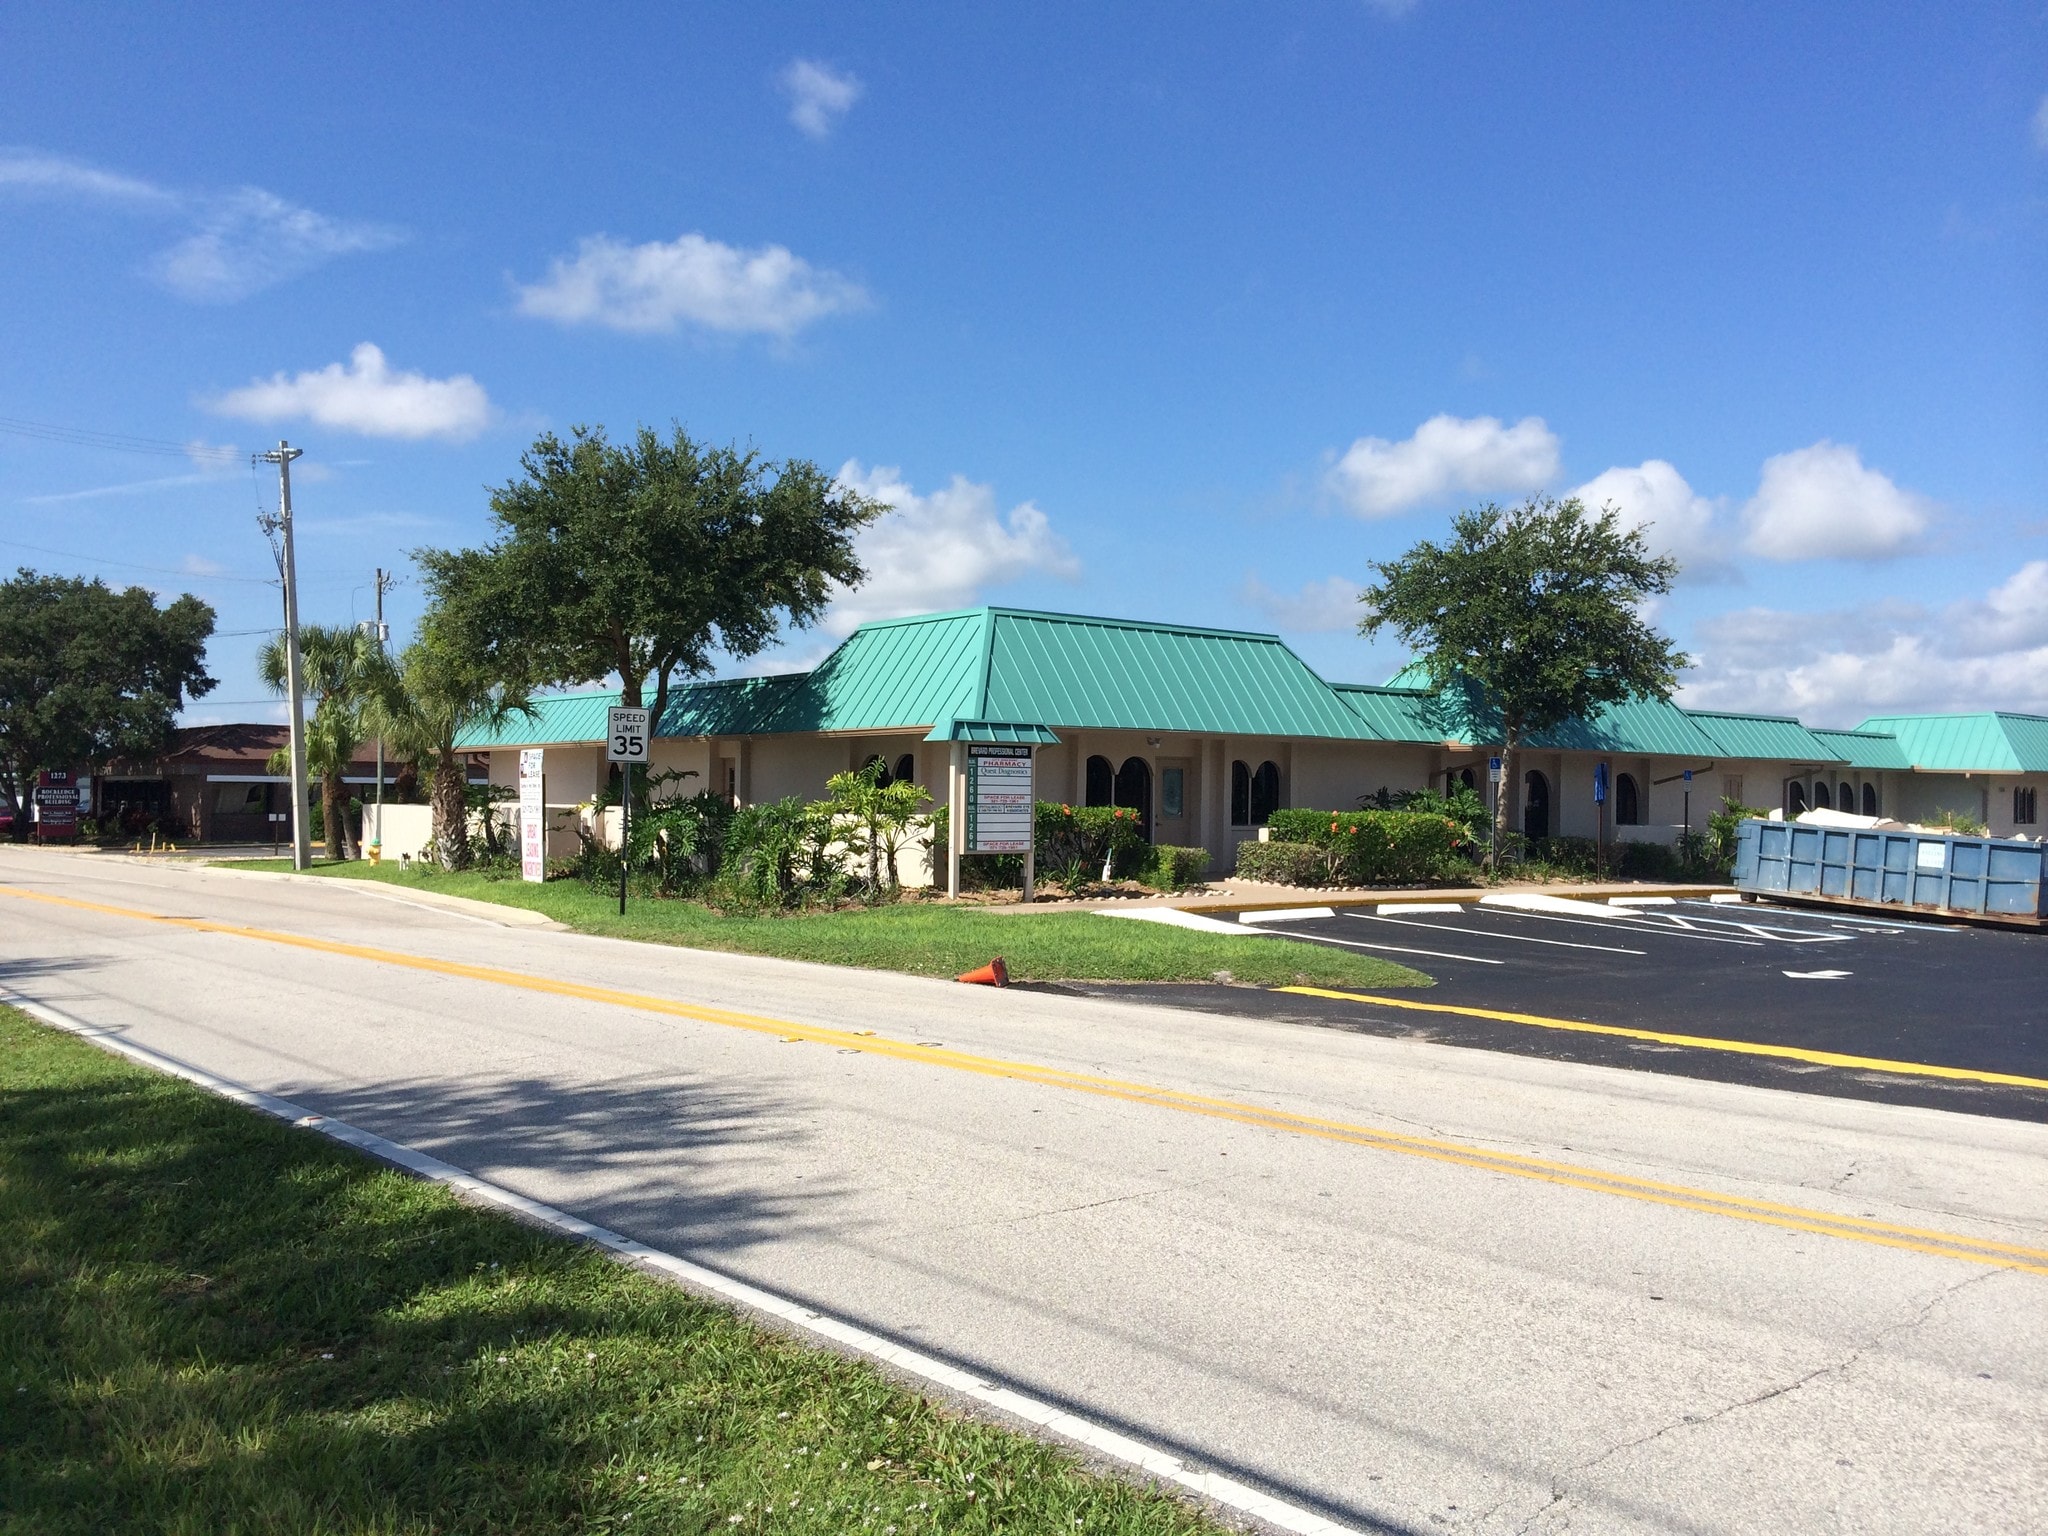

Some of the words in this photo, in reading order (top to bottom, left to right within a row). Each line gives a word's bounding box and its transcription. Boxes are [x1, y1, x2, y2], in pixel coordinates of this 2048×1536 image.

[613, 713, 645, 722] SPEED
[616, 724, 641, 733] LIMIT
[613, 736, 643, 755] 35
[989, 747, 1014, 755] PROFESSIONAL
[529, 752, 542, 760] SPACE
[528, 770, 541, 778] LEASE
[981, 767, 997, 776] Quest
[999, 767, 1028, 776] Diagnostics
